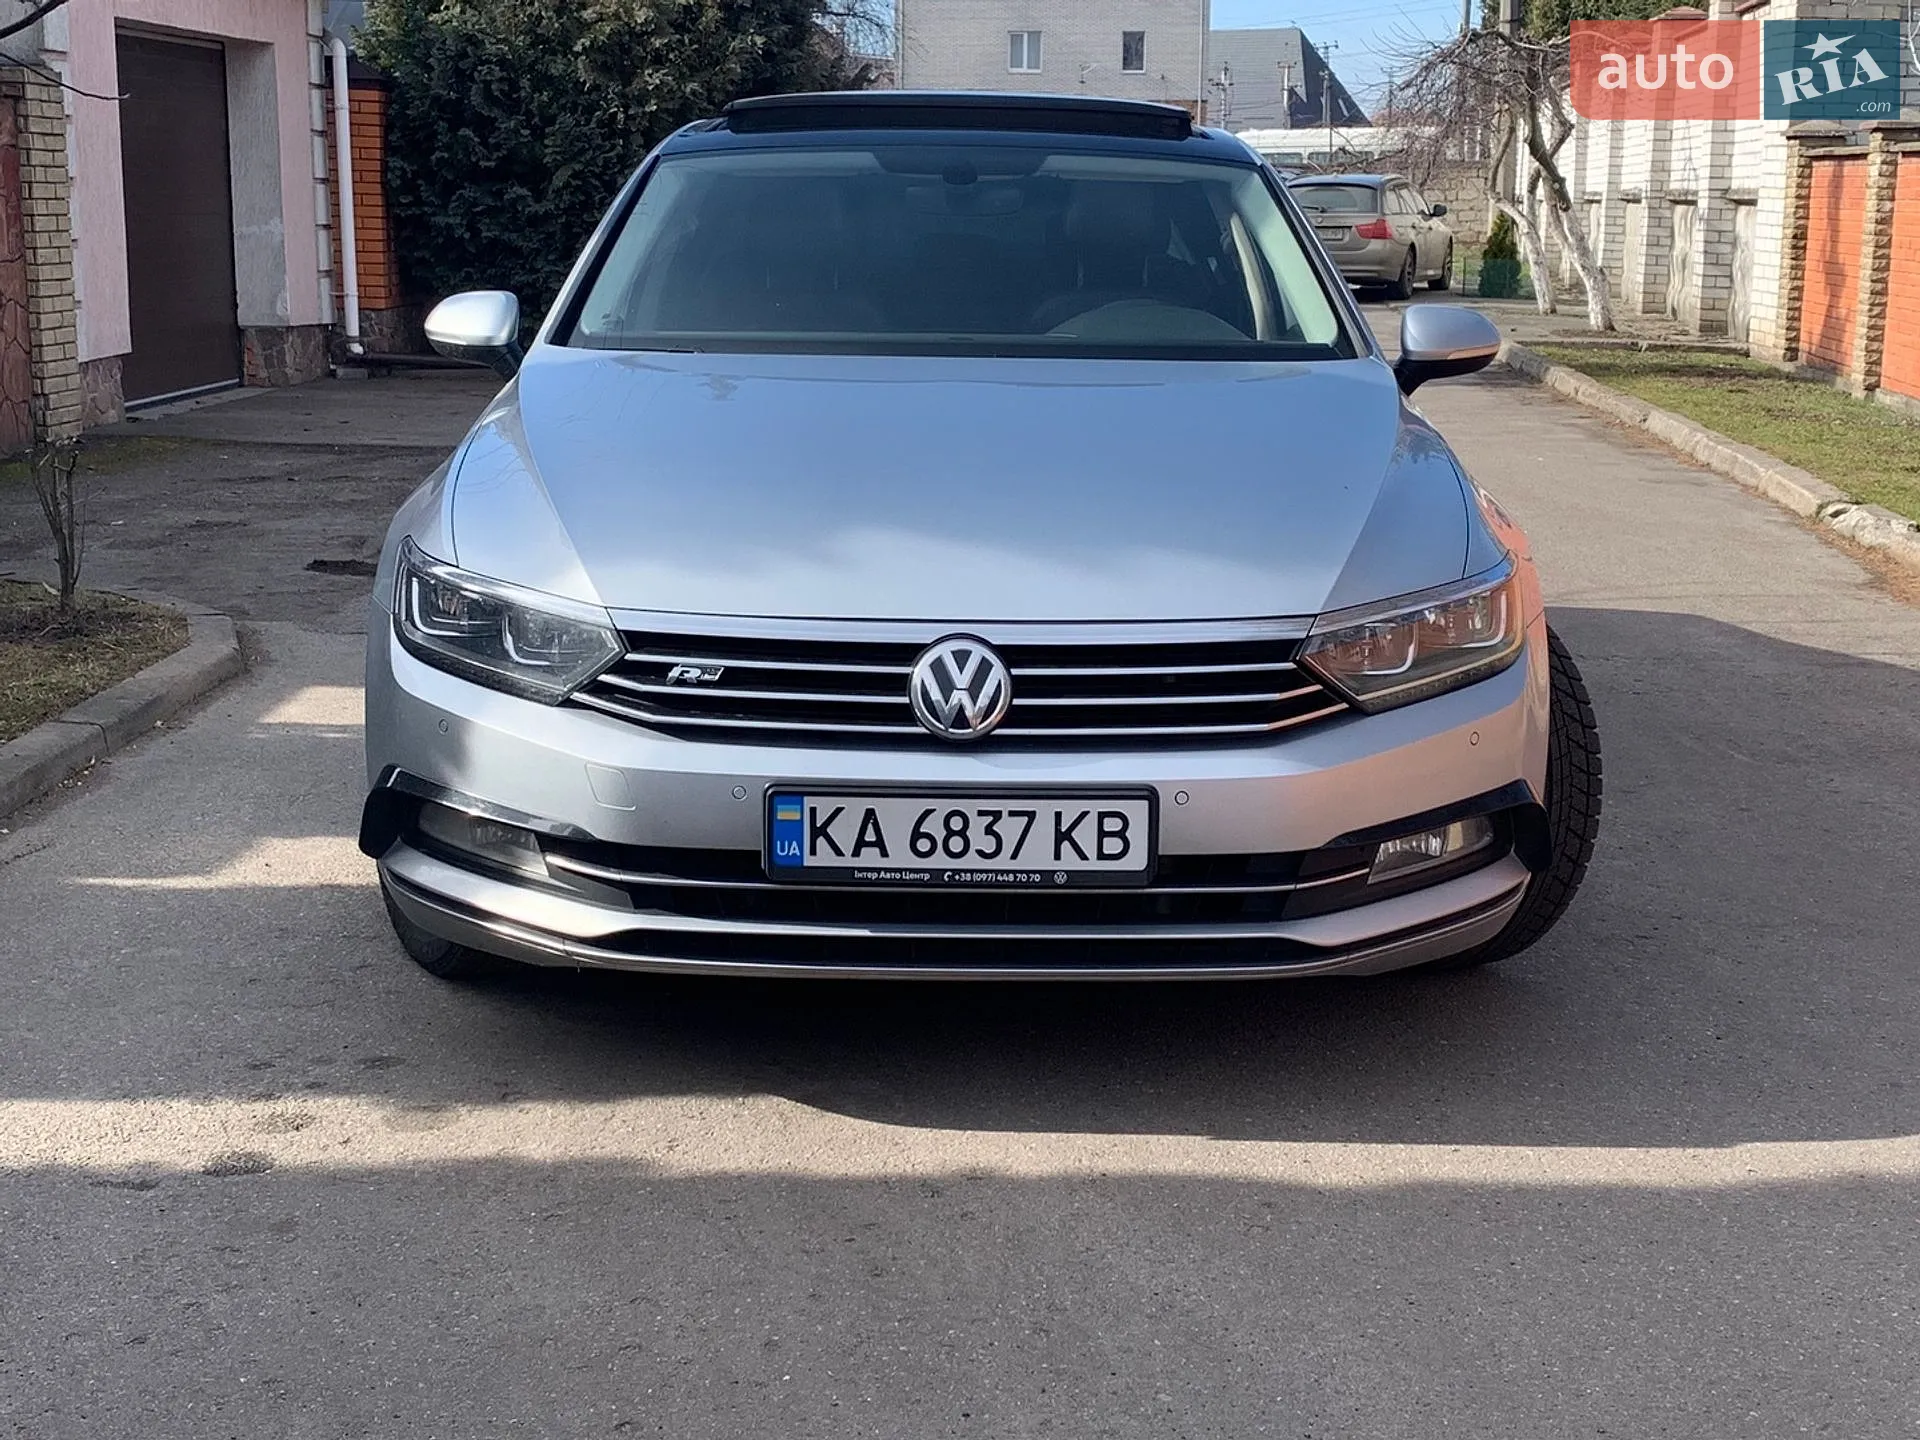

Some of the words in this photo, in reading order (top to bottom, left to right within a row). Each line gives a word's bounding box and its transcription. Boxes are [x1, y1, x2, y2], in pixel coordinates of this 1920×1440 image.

[808, 806, 890, 858] KA
[908, 808, 1037, 861] 6837
[1053, 810, 1131, 862] KB
[777, 840, 800, 856] UA
[854, 870, 878, 880] Інтер
[879, 870, 901, 880] Авто
[902, 871, 931, 881] Центр
[954, 873, 971, 881] +38
[973, 872, 996, 882] (097)
[997, 873, 1015, 882] 448
[1016, 873, 1028, 882] 70
[1029, 873, 1041, 882] 70
